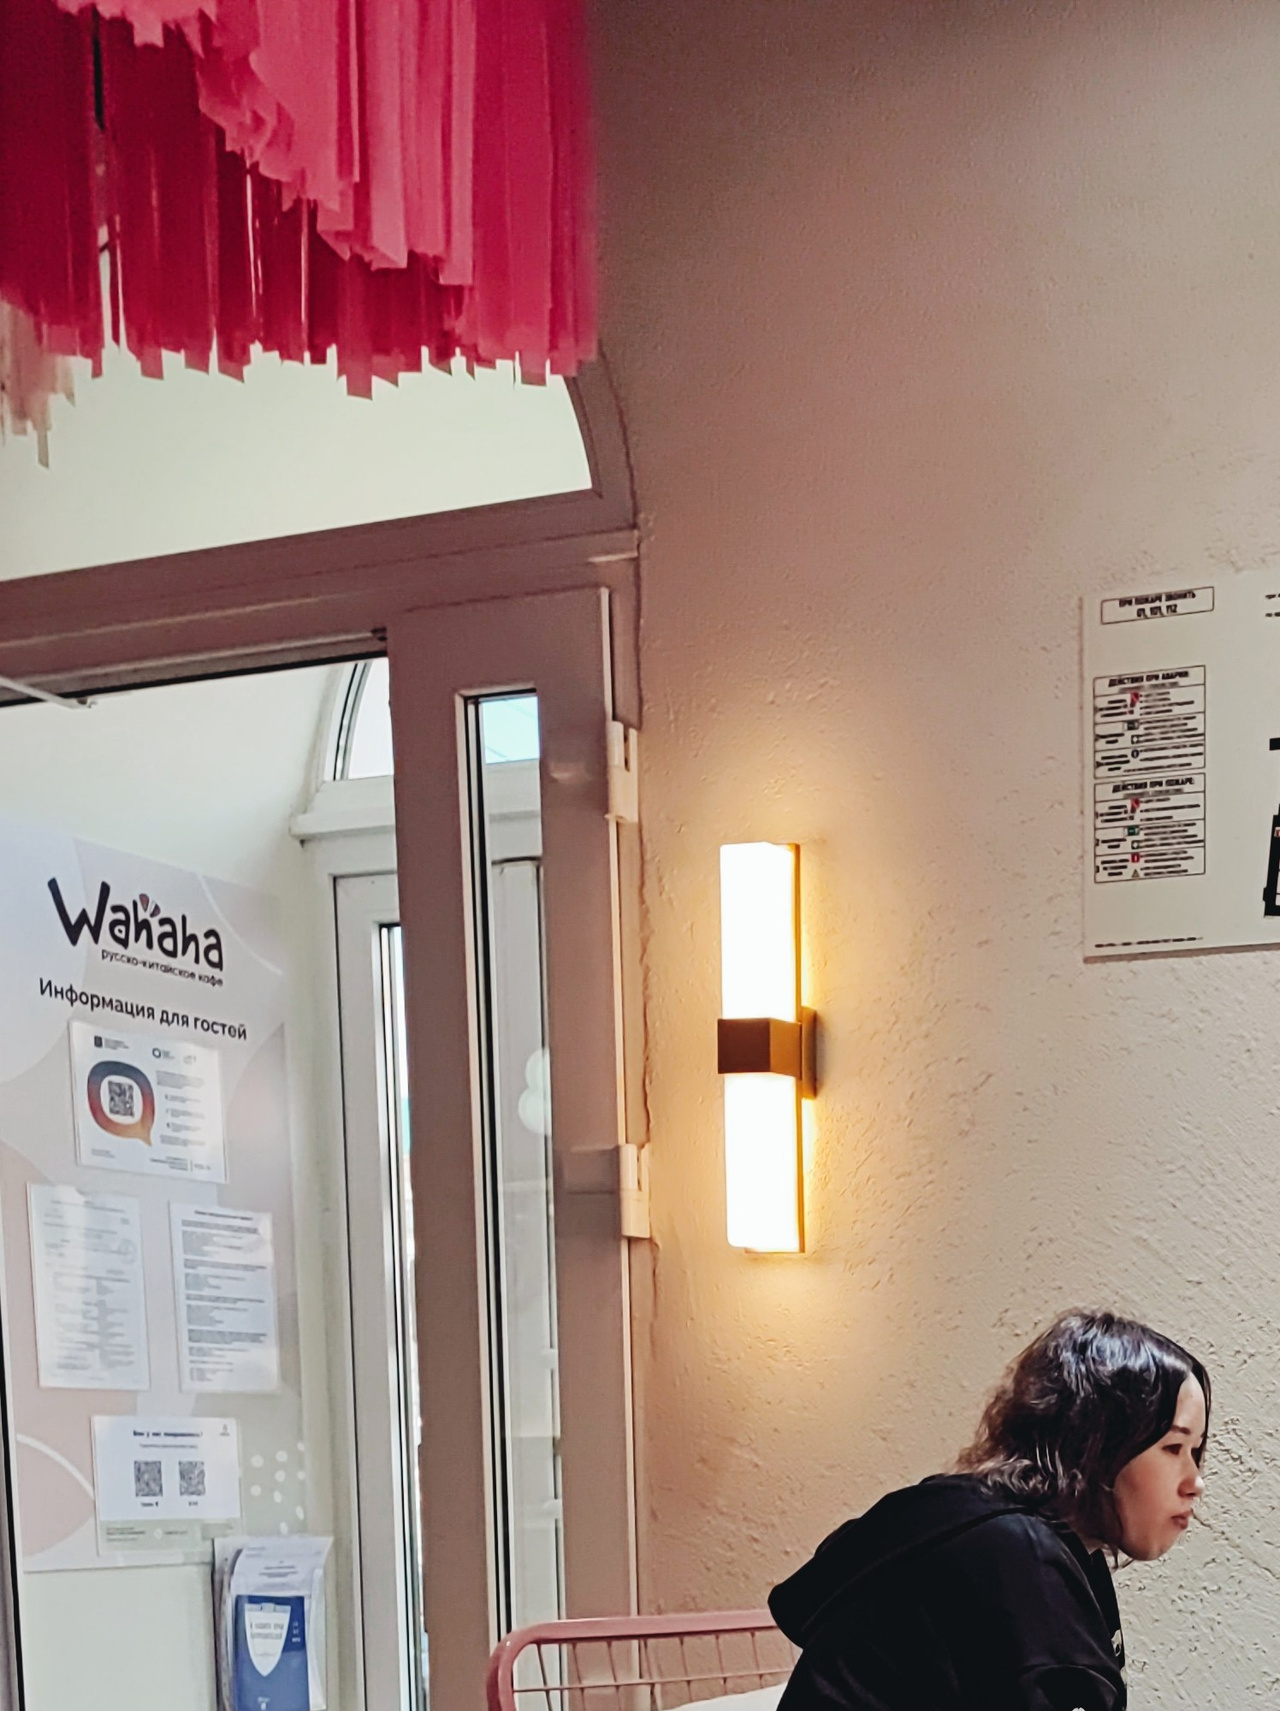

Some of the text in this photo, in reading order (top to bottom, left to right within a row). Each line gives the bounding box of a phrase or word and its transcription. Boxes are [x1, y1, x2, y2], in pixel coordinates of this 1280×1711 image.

[47, 877, 224, 972] Wahaha
[39, 977, 247, 1041] Информация для гостей
